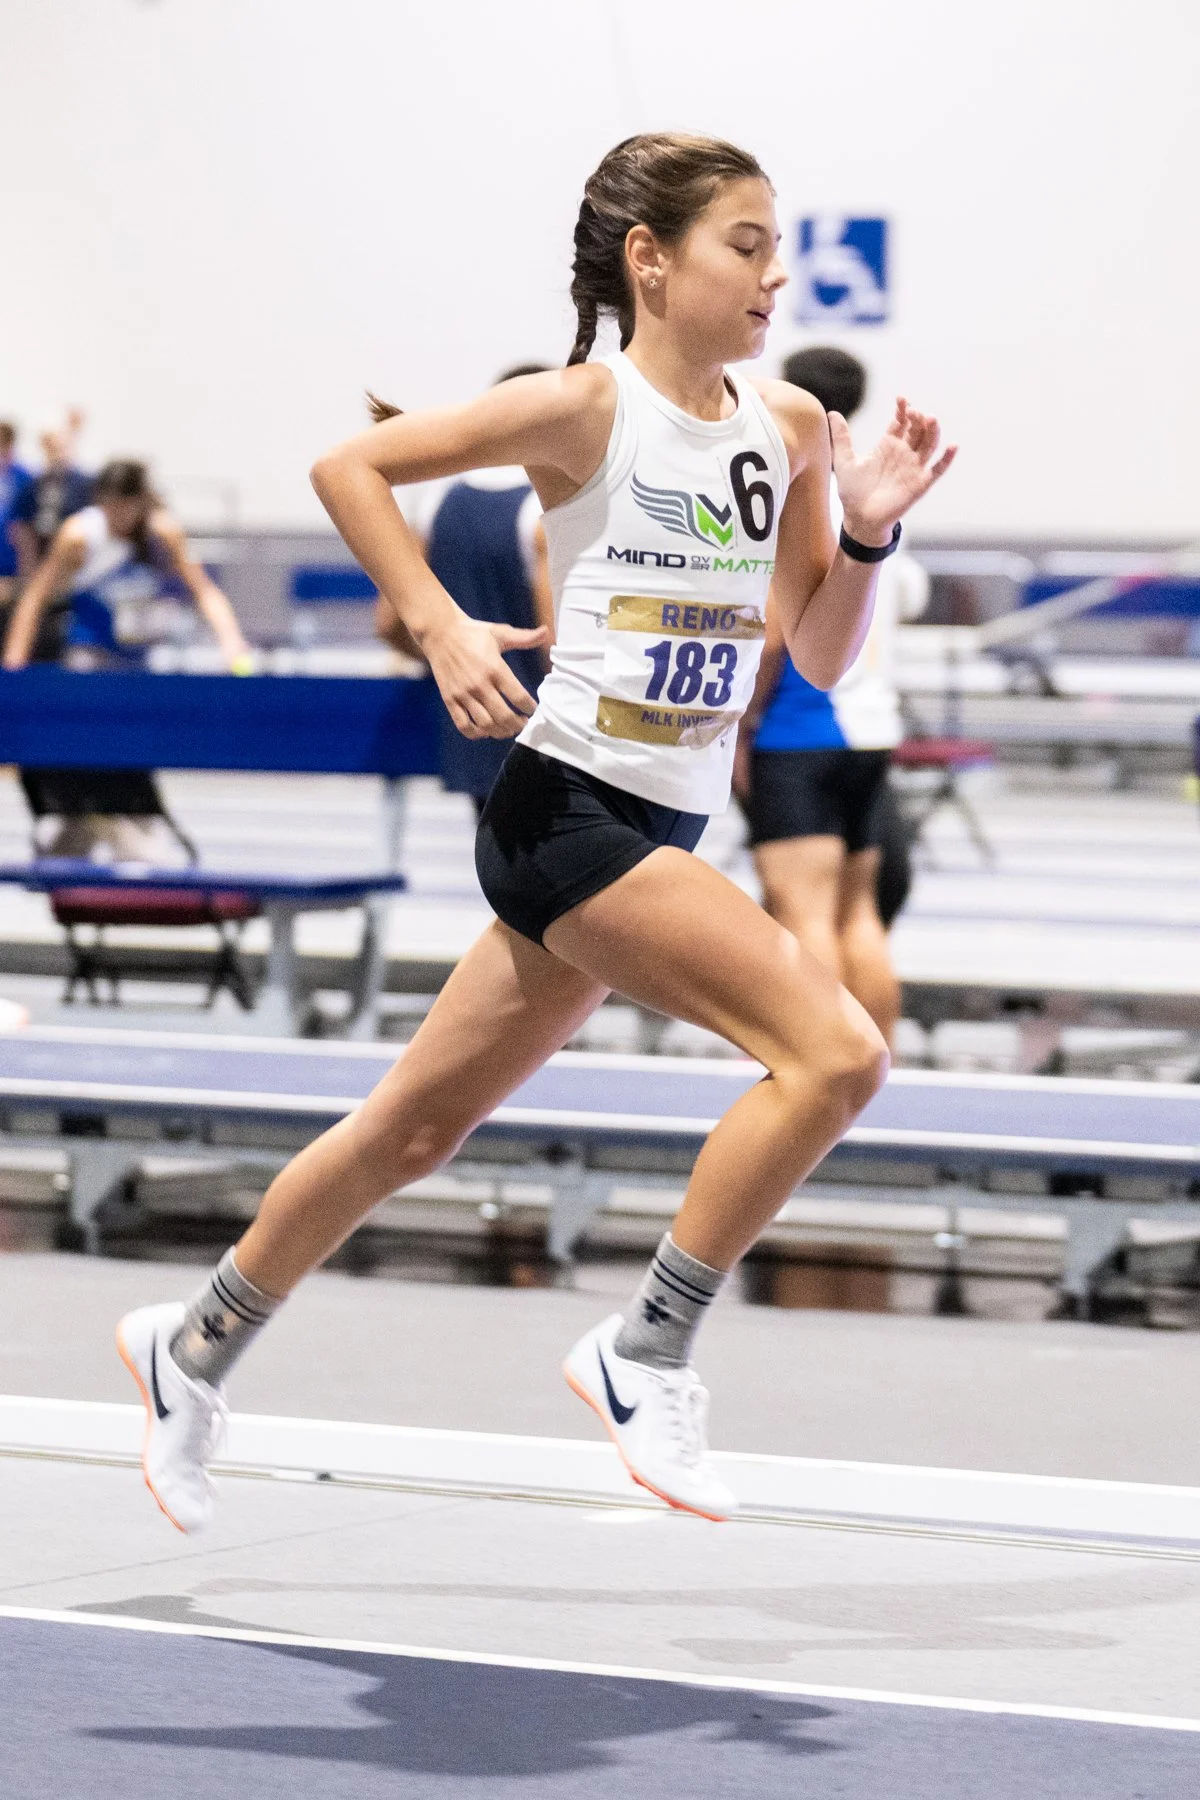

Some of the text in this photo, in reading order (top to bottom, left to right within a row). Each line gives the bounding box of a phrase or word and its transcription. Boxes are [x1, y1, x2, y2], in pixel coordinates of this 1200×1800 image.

[729, 451, 775, 542] 6
[607, 545, 686, 569] MIND
[661, 603, 736, 631] RENO
[644, 640, 738, 707] 183
[641, 710, 673, 727] MLK
